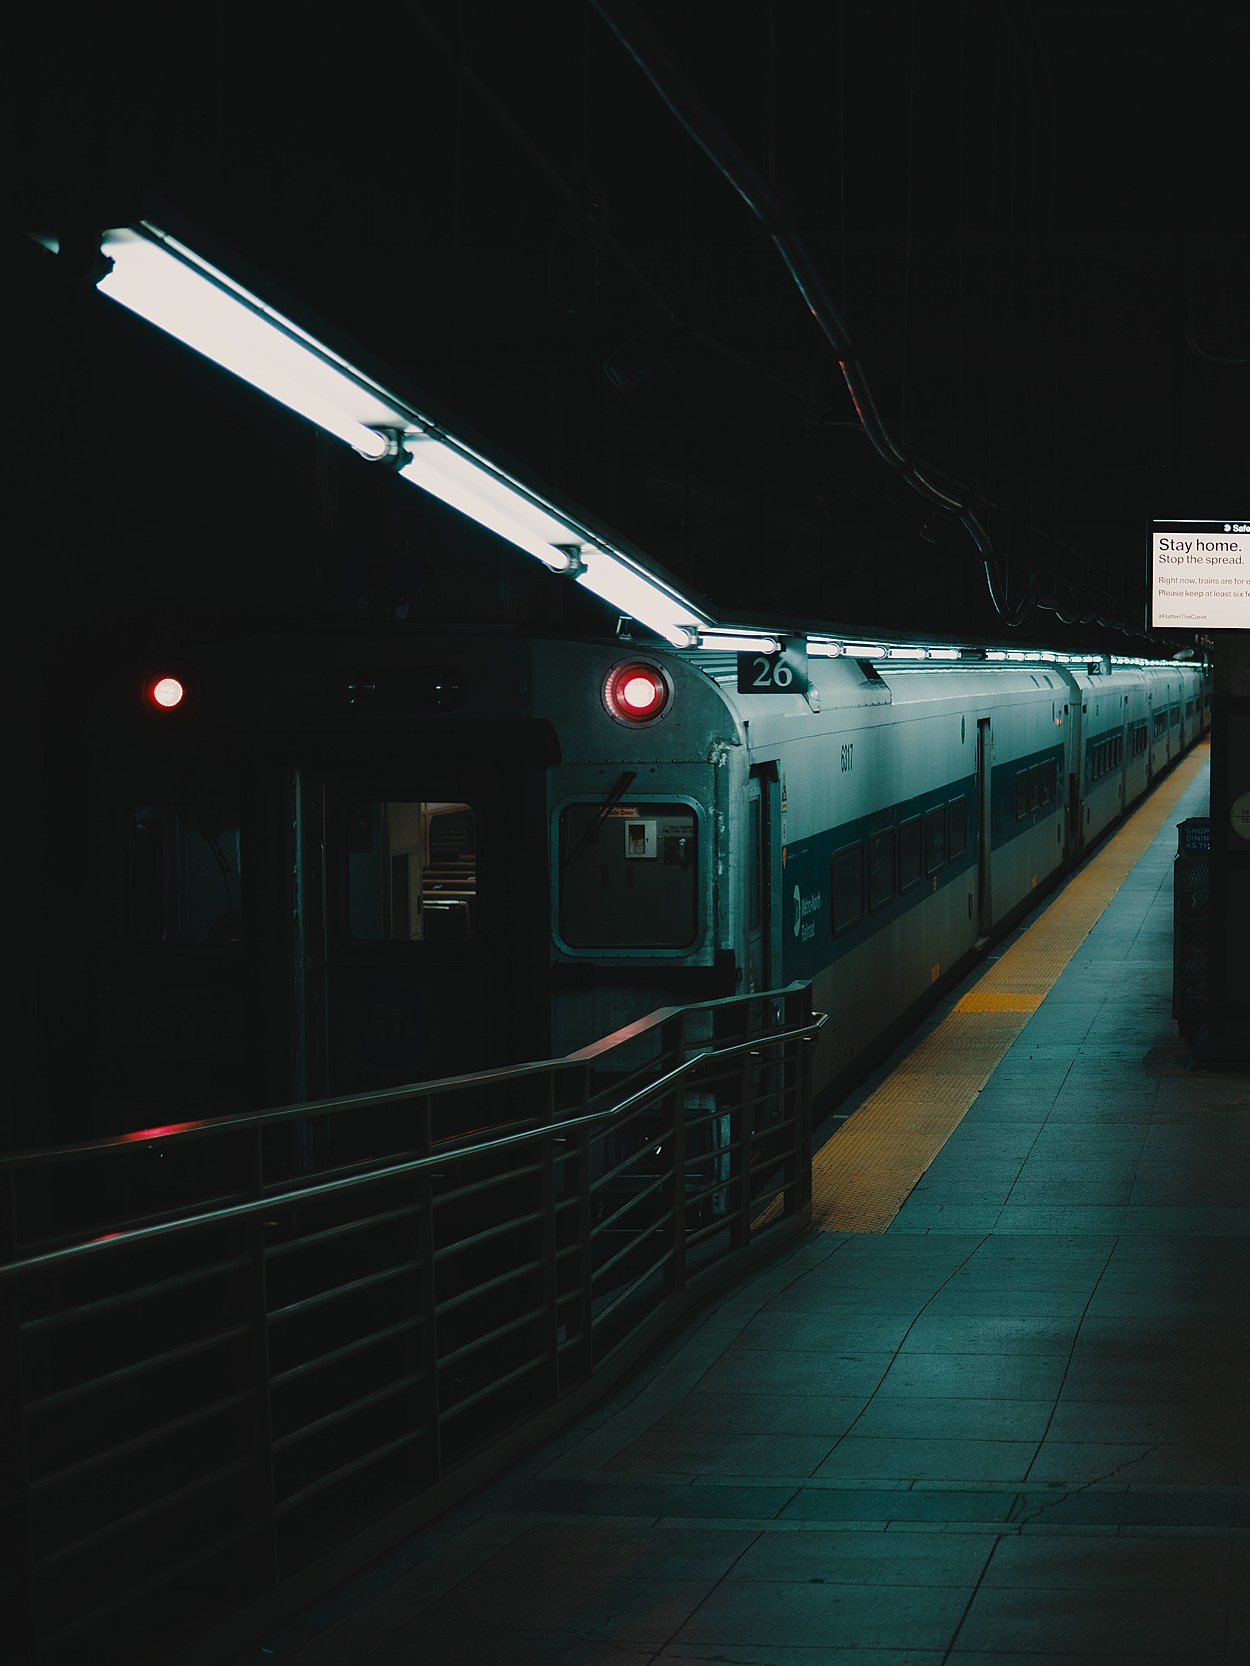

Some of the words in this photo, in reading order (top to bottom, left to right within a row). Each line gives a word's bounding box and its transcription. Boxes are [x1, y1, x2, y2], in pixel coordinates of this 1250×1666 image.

[1233, 524, 1250, 532] Safe
[1159, 538, 1192, 553] Stay
[1196, 539, 1242, 552] home.
[1159, 554, 1184, 565] Stop
[1186, 555, 1203, 564] the
[1205, 556, 1244, 566] spread.
[1158, 577, 1178, 585] Right
[1185, 590, 1204, 598] keep
[752, 656, 794, 687] 26
[840, 744, 853, 772] 6317
[1185, 827, 1209, 835] SHOP
